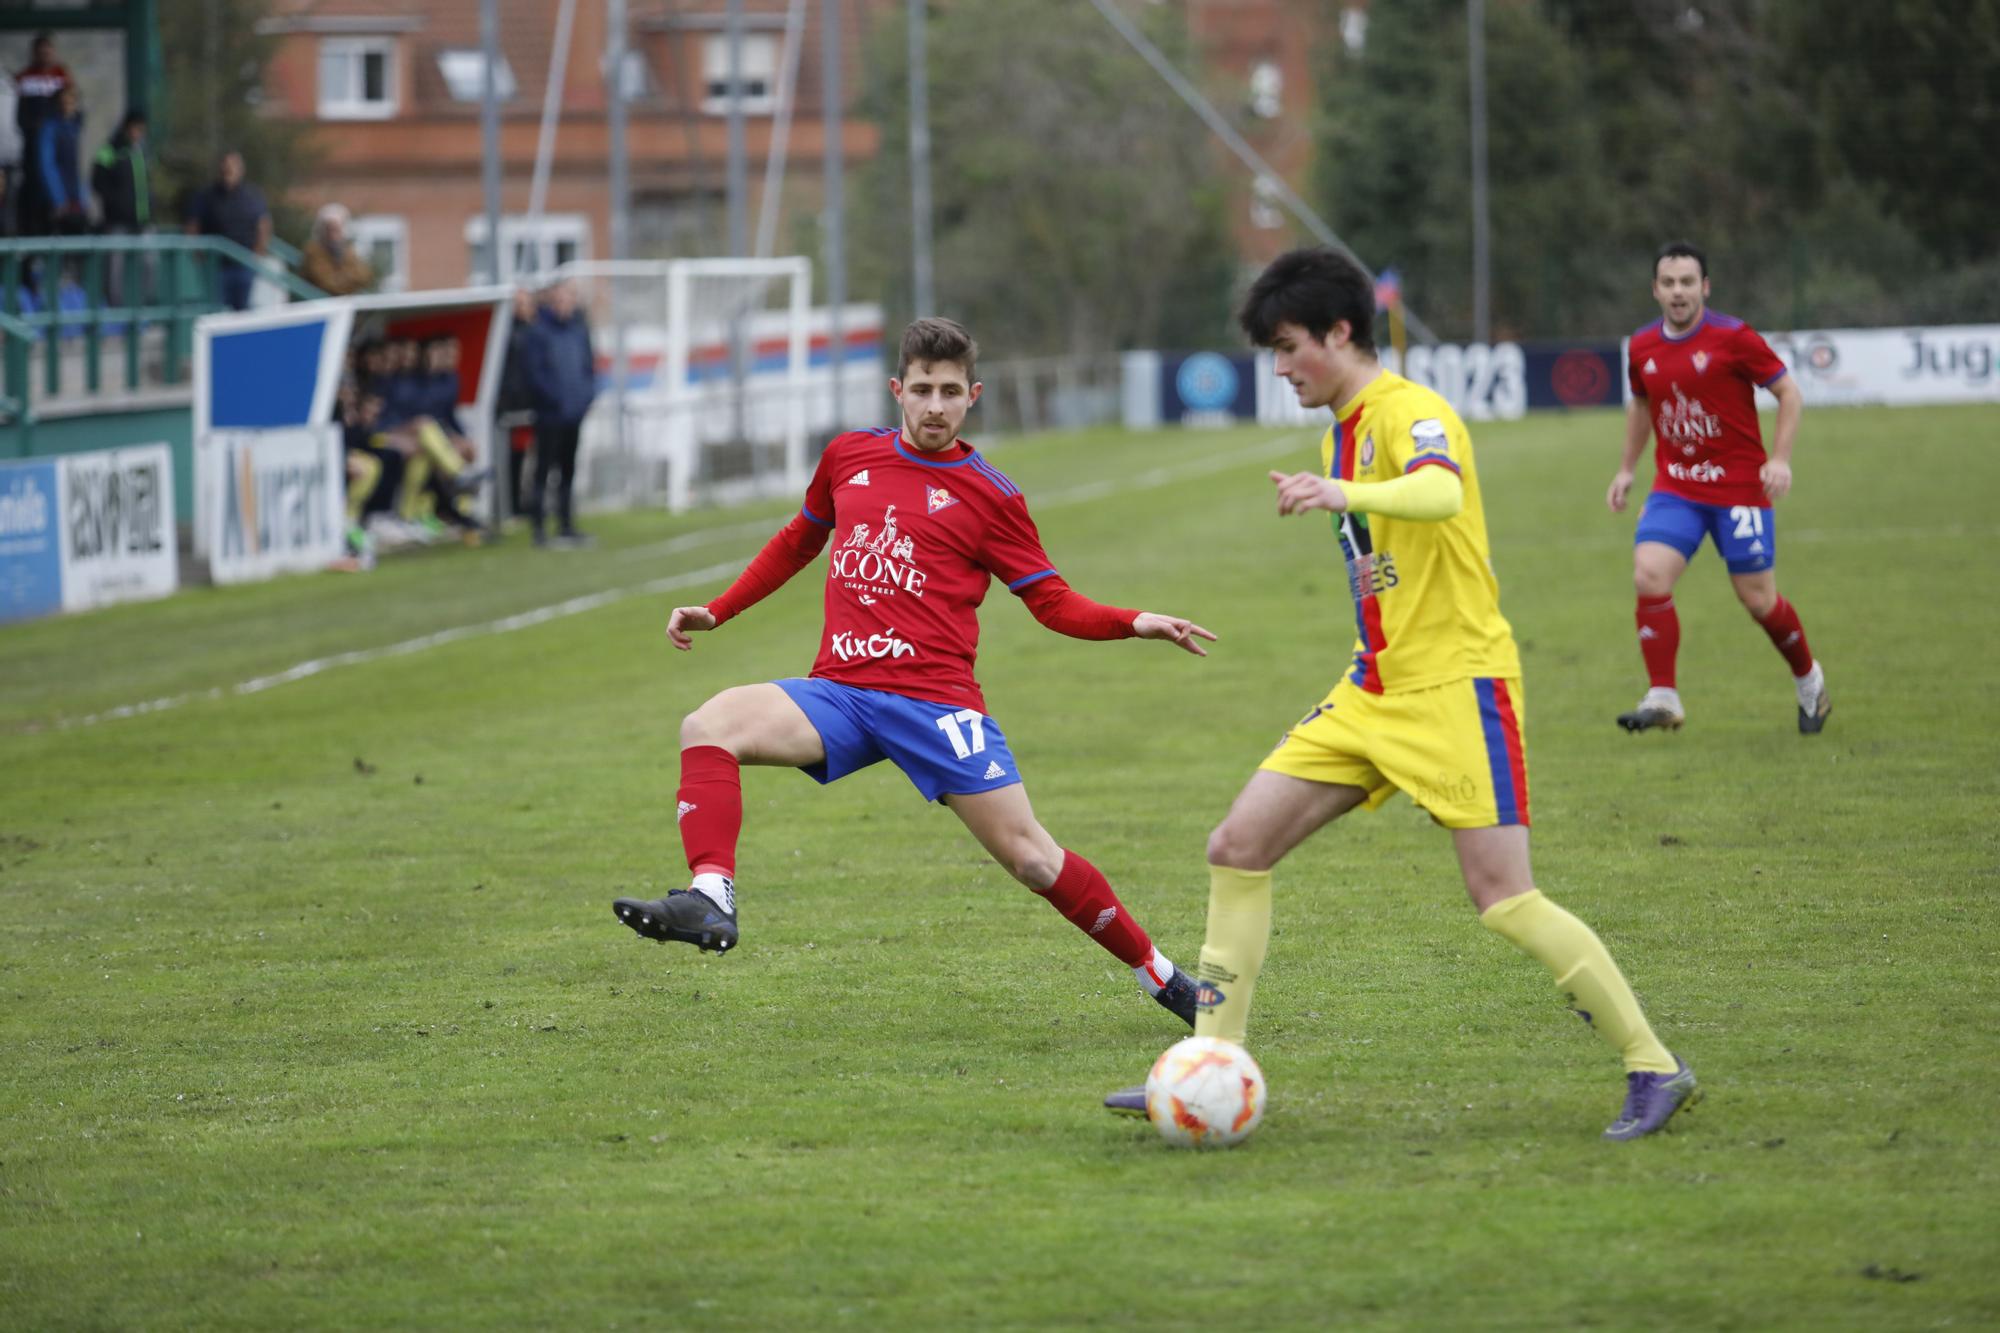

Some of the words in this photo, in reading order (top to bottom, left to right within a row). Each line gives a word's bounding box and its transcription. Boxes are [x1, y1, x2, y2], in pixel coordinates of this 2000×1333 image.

[1730, 505, 1764, 539] 21
[831, 549, 927, 598] SCONE
[935, 708, 985, 760] 17
